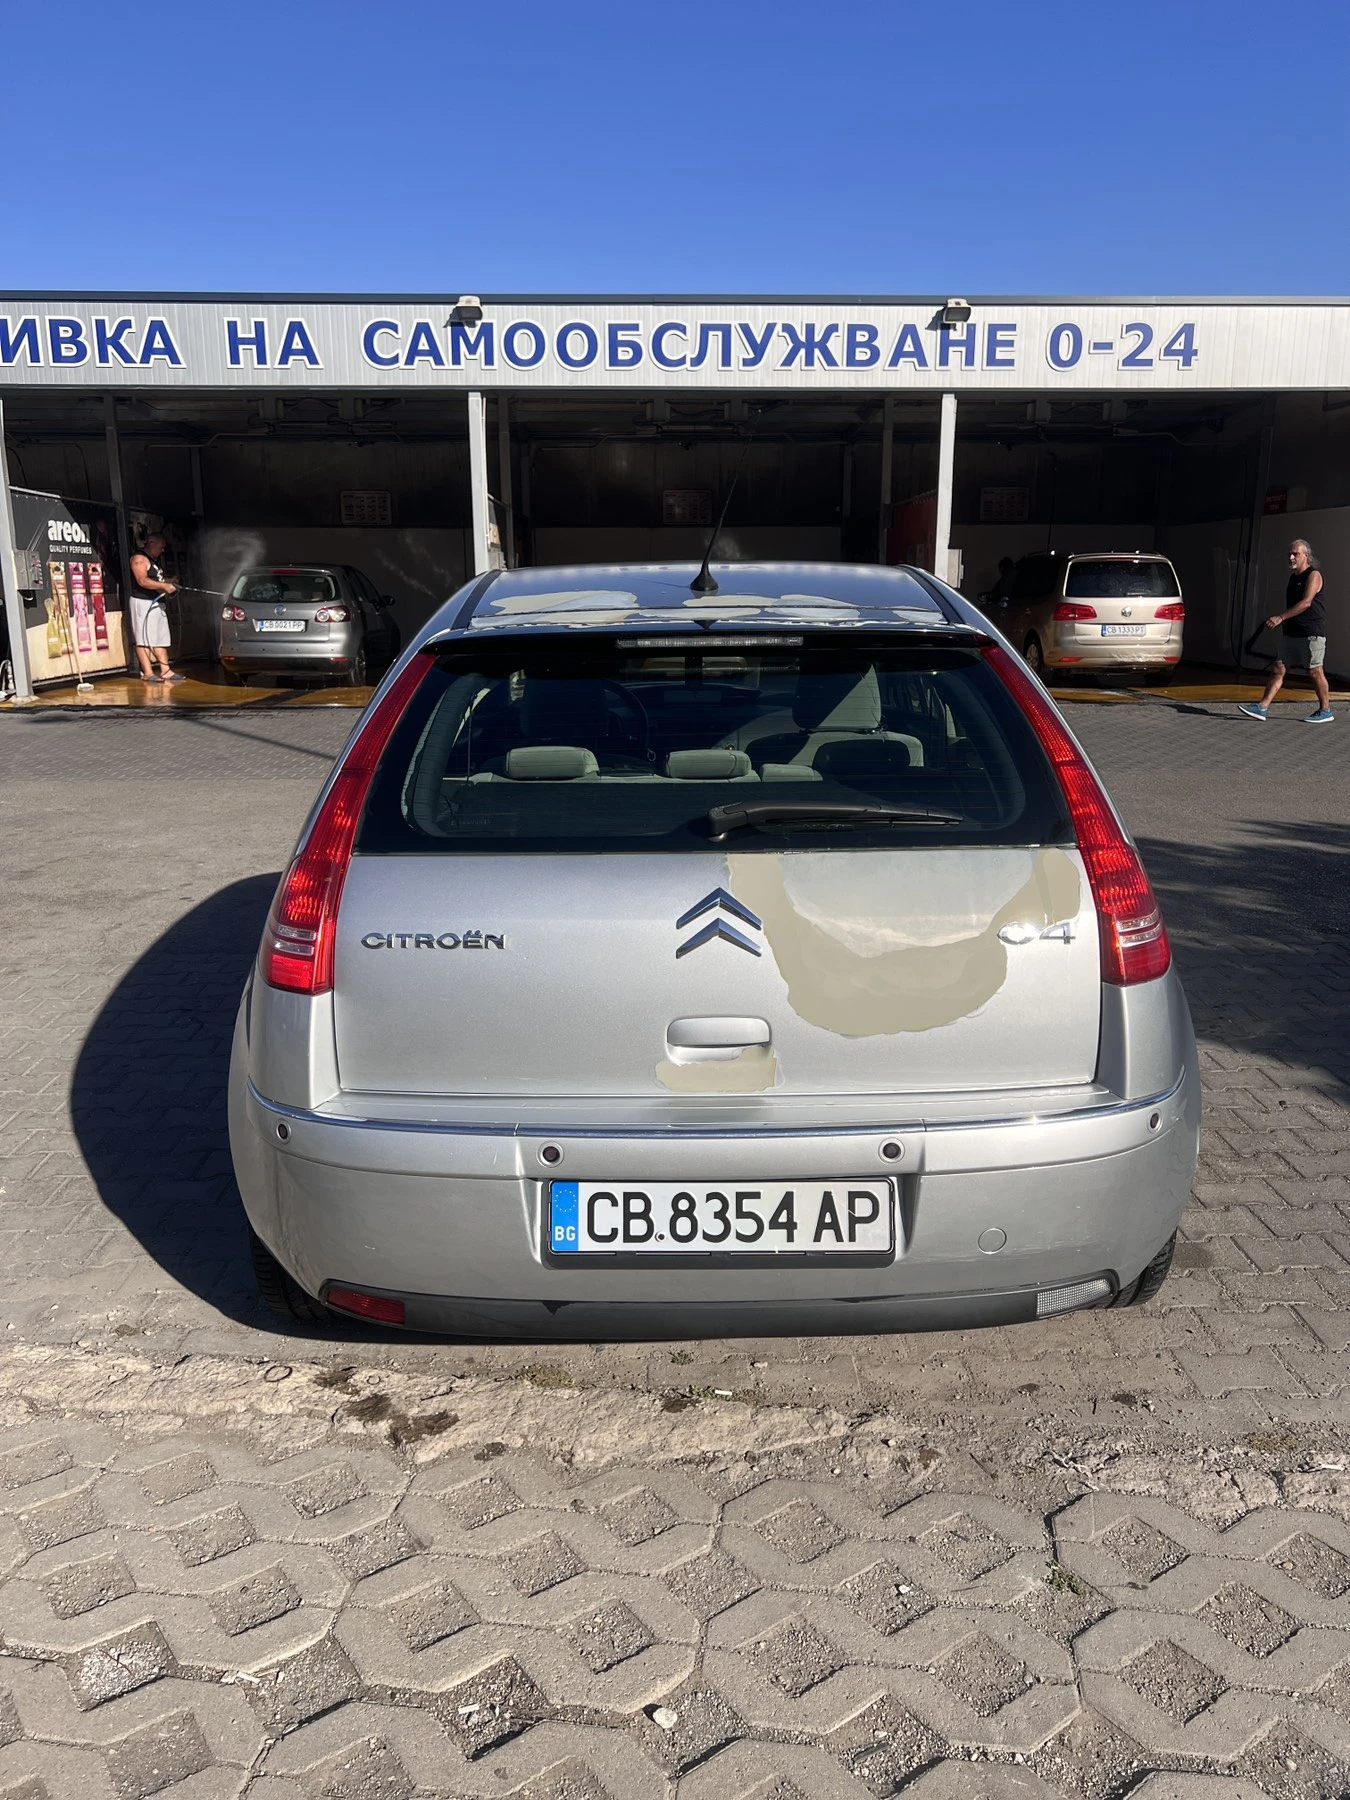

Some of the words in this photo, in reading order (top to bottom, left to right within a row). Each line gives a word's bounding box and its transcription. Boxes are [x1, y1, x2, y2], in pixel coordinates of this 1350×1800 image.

[0, 316, 185, 367] ИВКА
[224, 318, 323, 369] НА
[362, 319, 1017, 371] САМООБСЛУЖВАНЕ
[1046, 322, 1198, 371] 0-24
[47, 519, 91, 543] areon
[49, 544, 69, 553] QUALITY
[69, 545, 92, 554] PERFUMES
[361, 930, 506, 949] CITROËN
[669, 1191, 798, 1243] 8354
[813, 1191, 880, 1243] AP
[555, 1226, 576, 1241] BG
